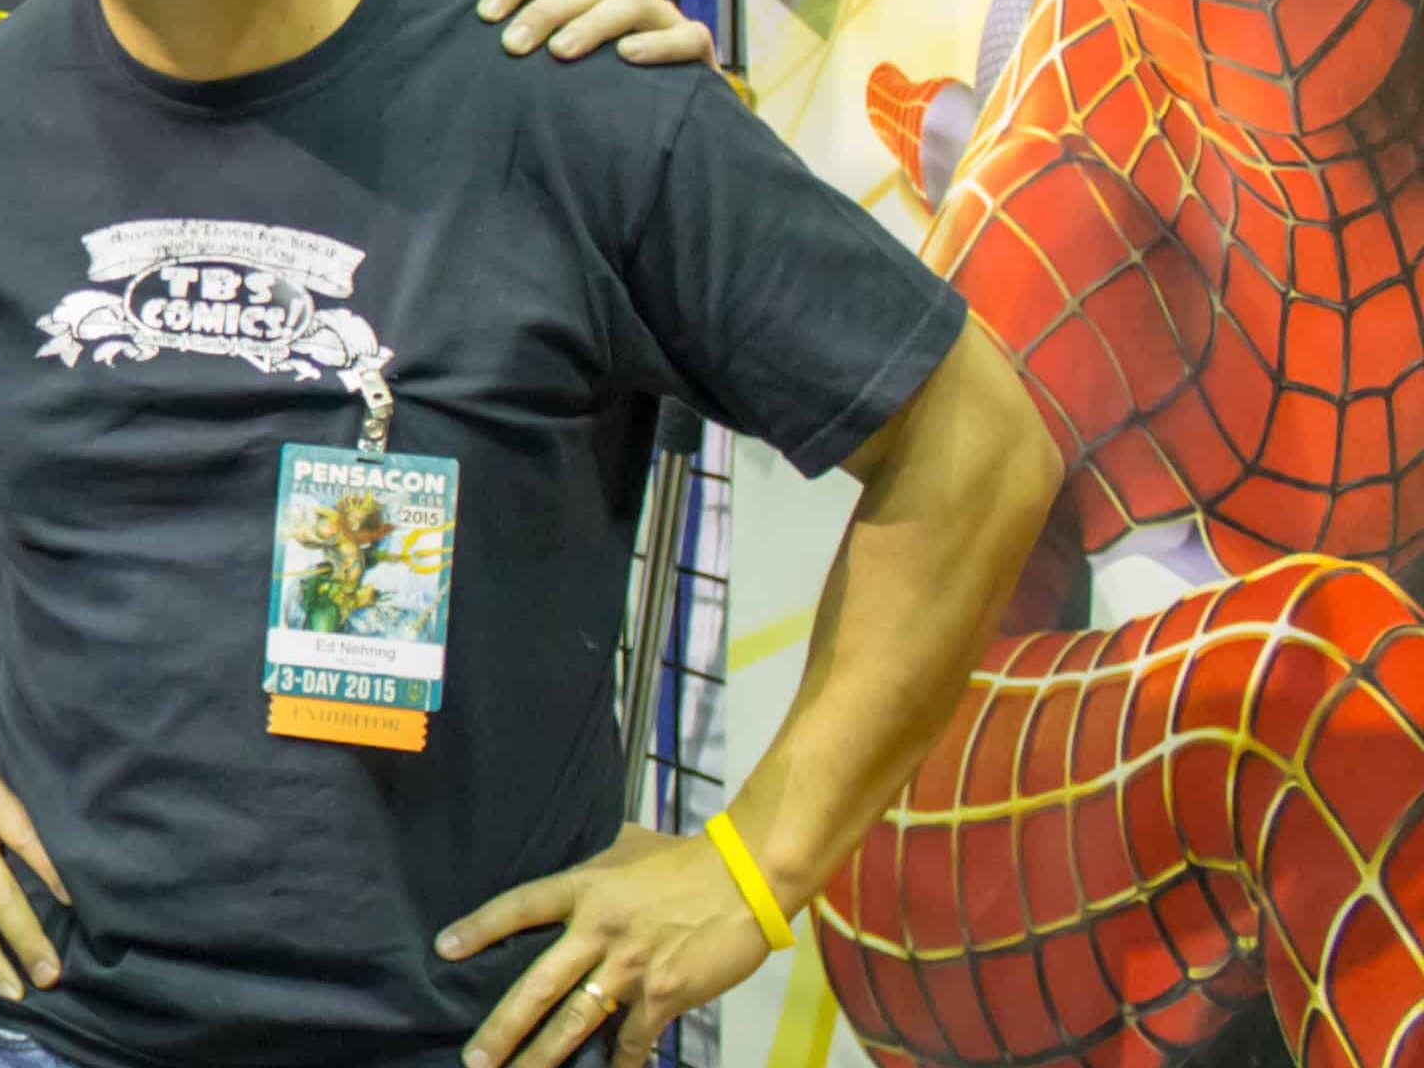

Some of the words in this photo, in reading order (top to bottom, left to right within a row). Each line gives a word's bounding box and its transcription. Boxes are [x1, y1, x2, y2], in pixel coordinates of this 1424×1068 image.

[160, 266, 276, 304] TBS
[294, 460, 446, 494] PENSACON
[402, 510, 440, 525] 2015
[280, 666, 340, 696] 3-DAY
[344, 675, 396, 704] 2015
